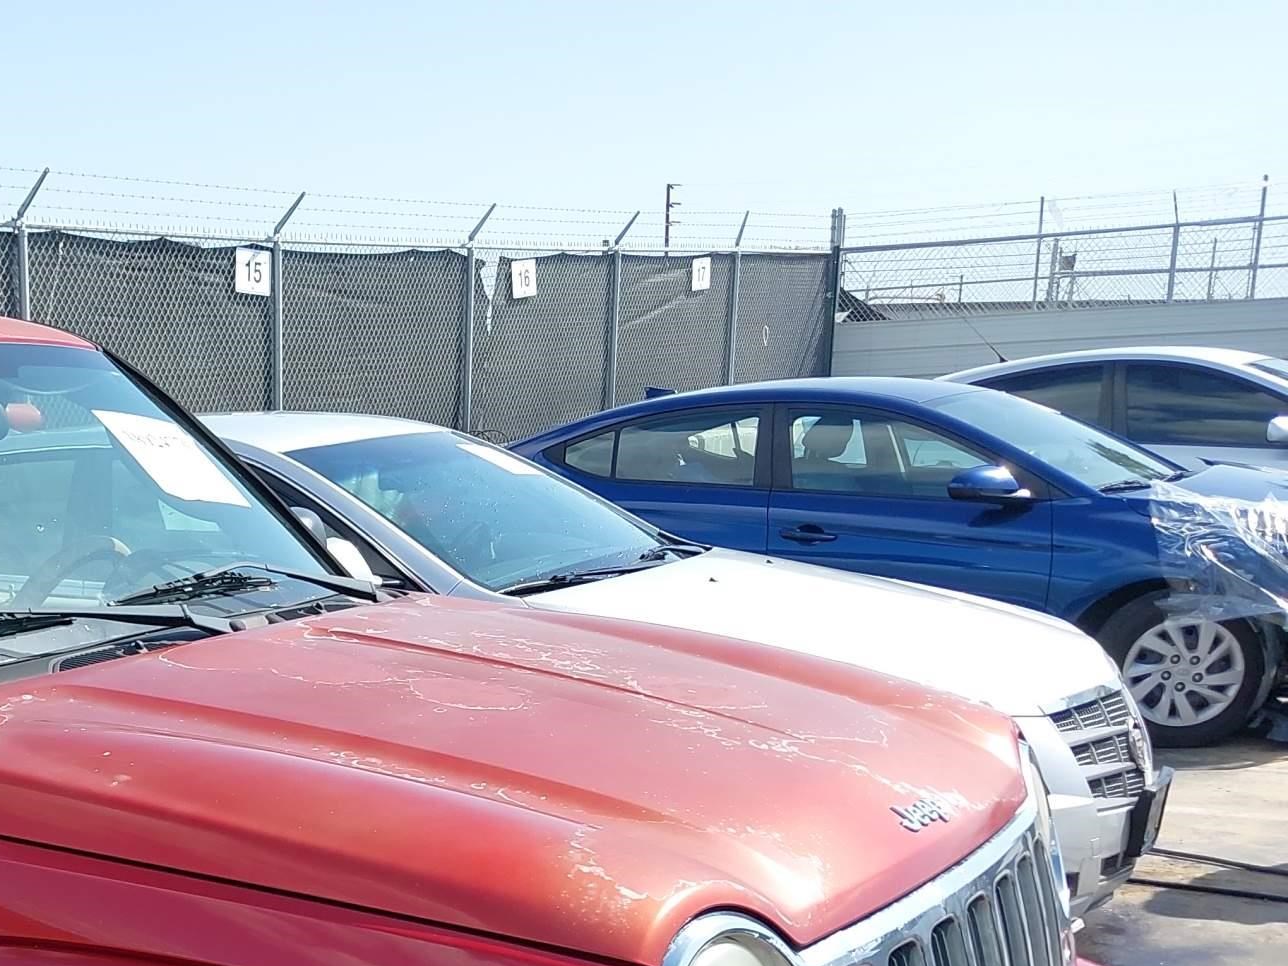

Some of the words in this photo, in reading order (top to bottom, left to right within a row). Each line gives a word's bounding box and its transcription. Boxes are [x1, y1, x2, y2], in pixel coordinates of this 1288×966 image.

[245, 260, 262, 284] 15
[518, 269, 530, 289] 16
[697, 265, 706, 282] 17
[889, 798, 950, 833] Jeep
